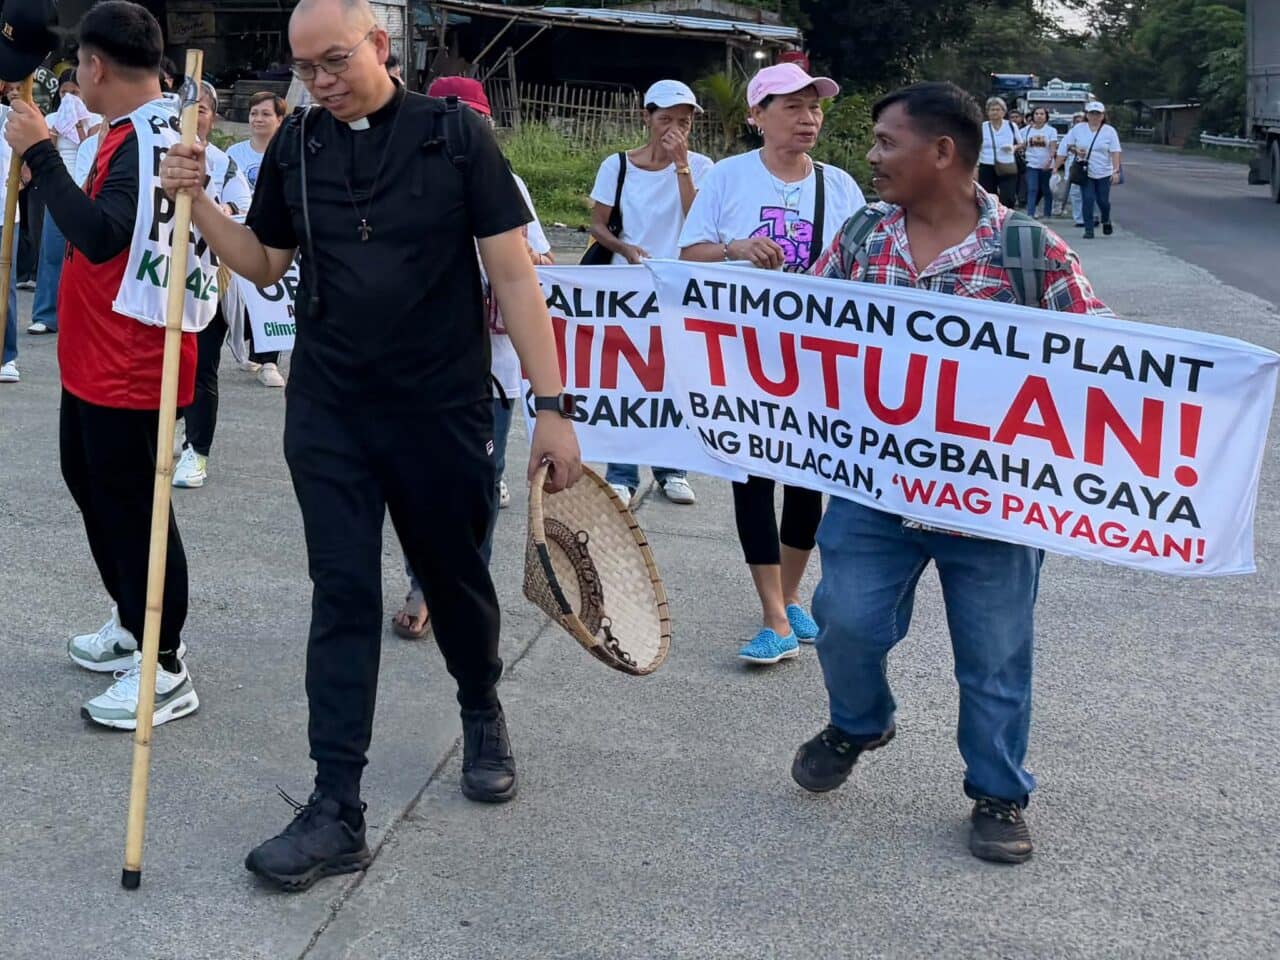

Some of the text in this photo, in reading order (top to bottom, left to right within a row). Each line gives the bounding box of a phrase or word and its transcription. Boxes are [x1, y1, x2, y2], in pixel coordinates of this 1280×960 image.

[682, 278, 1214, 392] ATIMONAN COAL PLANT
[684, 317, 1203, 487] TUTULAN!
[688, 391, 1201, 529] BANTA NG PAGBAHA GAYA
[697, 426, 741, 454] NG
[748, 434, 882, 499] BULACAN,
[1001, 494, 1206, 564] PAYAGAN!
